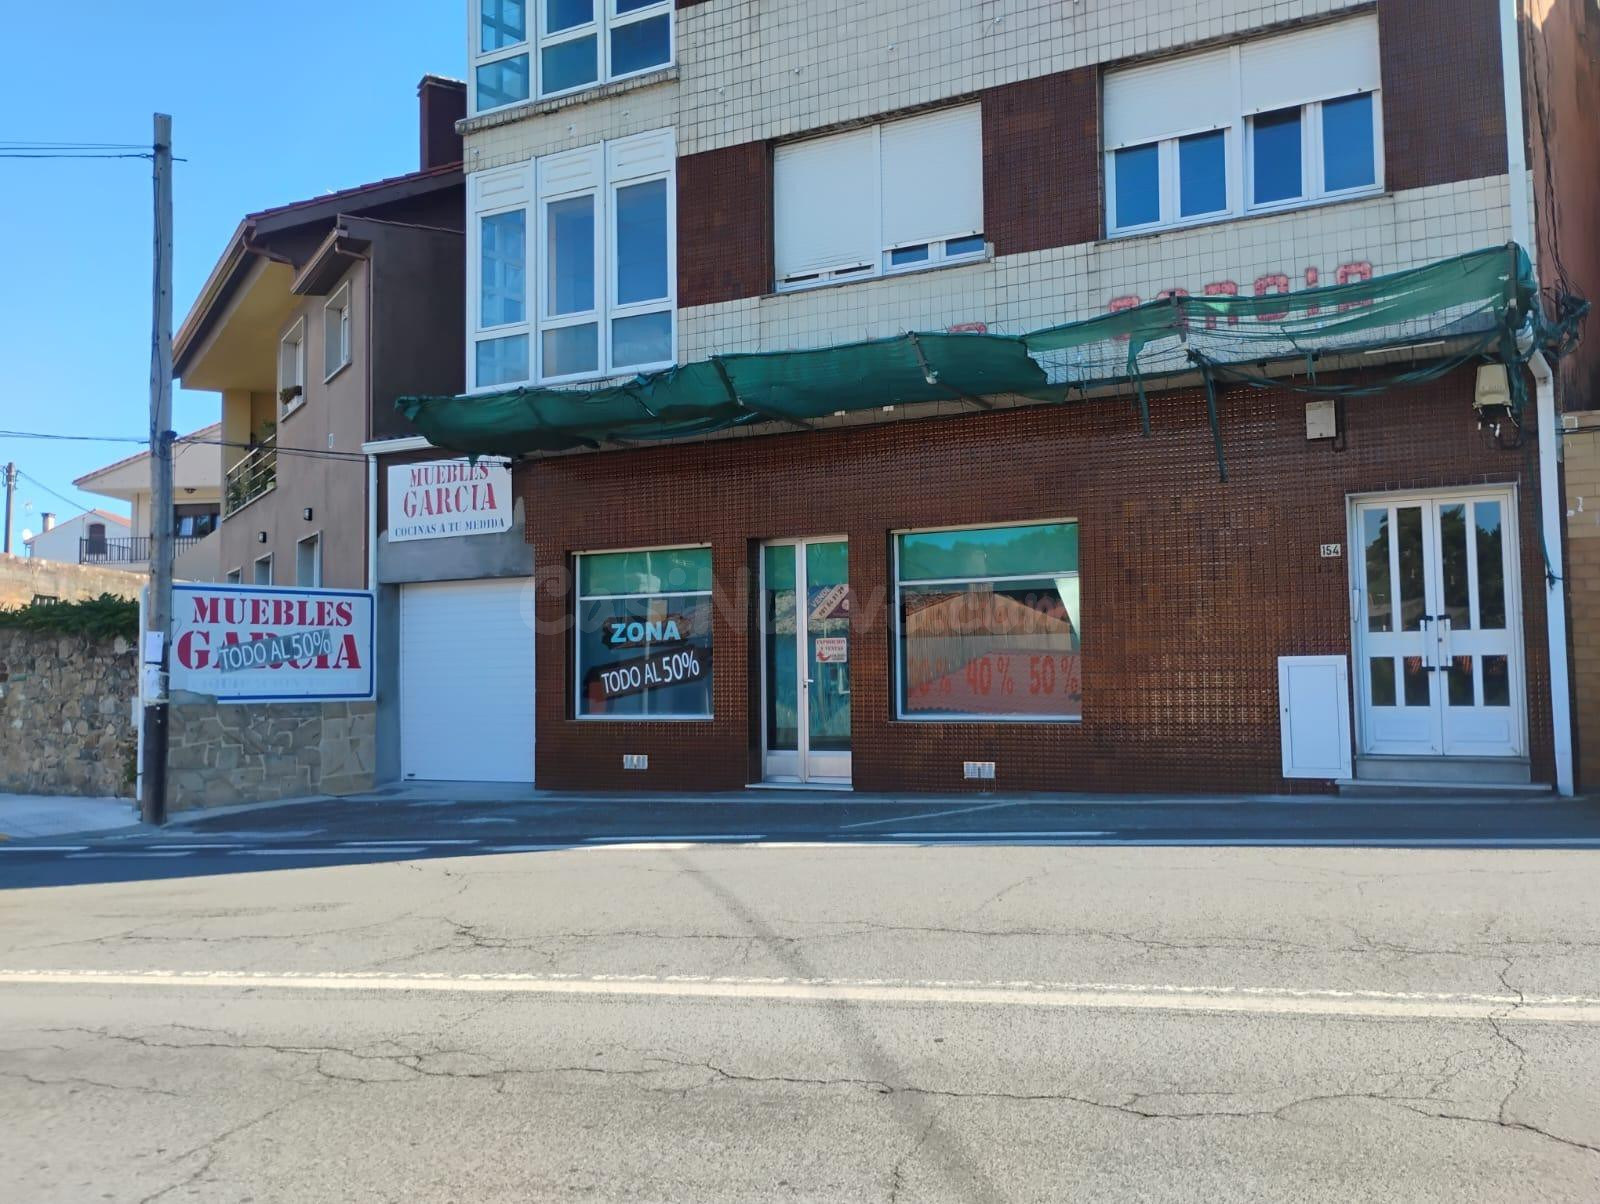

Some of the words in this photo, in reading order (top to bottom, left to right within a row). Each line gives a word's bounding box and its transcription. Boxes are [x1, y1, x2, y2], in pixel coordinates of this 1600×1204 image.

[410, 462, 489, 488] MUEBLES
[404, 482, 497, 518] GARCIA
[395, 523, 437, 537] COCINAS
[440, 523, 447, 533] A
[450, 521, 462, 532] TU
[465, 518, 505, 530] MEDIDA
[1322, 545, 1339, 555] 154
[192, 596, 353, 627] MUEBLES
[610, 620, 681, 643] ZONA
[219, 643, 266, 670] TODO
[271, 640, 291, 661] AL
[292, 630, 331, 660] 50%
[601, 666, 641, 693] TODO
[644, 662, 662, 684] AL
[662, 650, 700, 682] 50%
